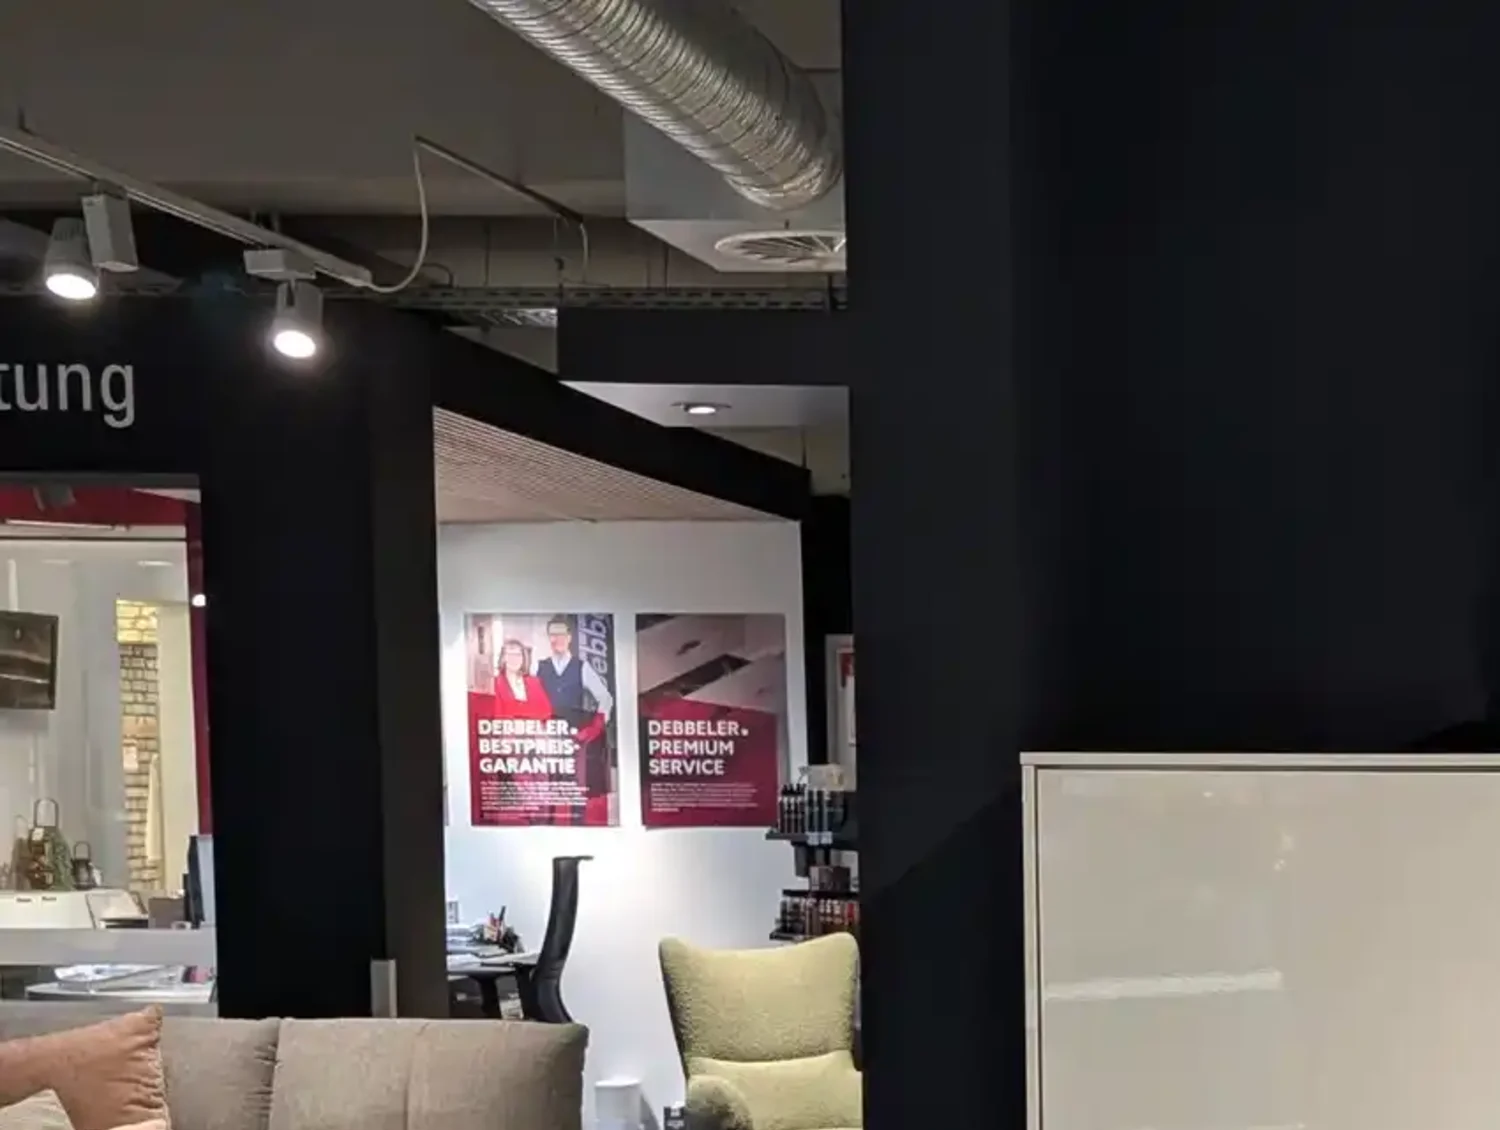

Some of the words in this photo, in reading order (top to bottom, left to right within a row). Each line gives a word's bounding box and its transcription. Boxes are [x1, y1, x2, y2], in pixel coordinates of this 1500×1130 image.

[478, 719, 578, 735] DEBBELER.
[648, 719, 749, 737] DEBBELER.
[648, 739, 734, 756] PREMIUM
[479, 757, 576, 775] GARANTIE
[648, 759, 725, 776] SERVICE
